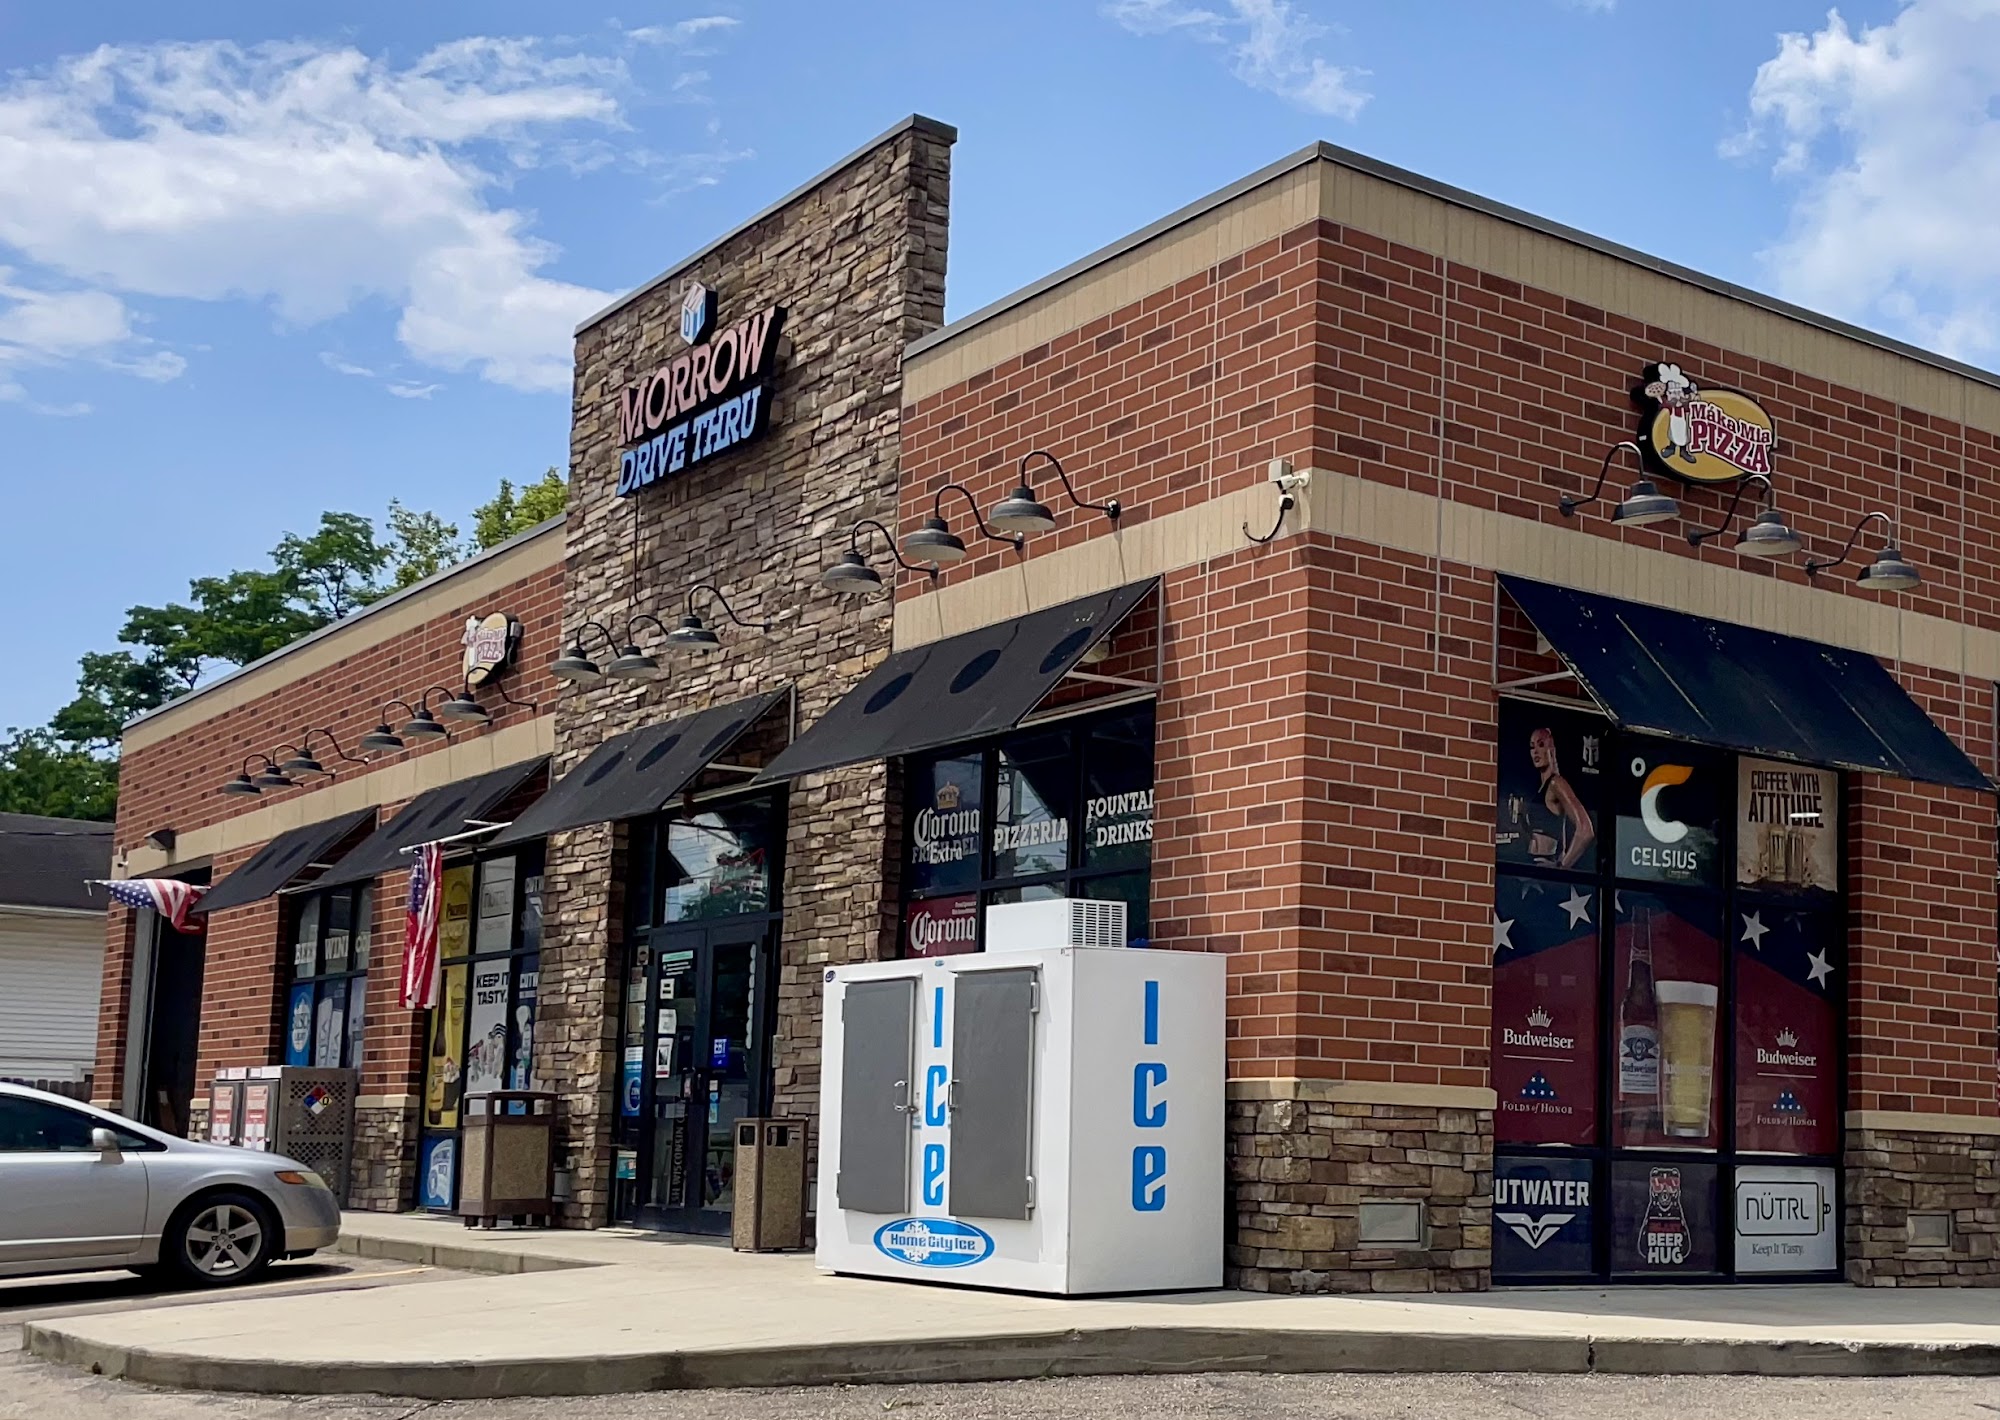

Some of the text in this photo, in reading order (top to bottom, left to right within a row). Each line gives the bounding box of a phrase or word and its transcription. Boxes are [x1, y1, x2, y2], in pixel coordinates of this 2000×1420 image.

[621, 305, 776, 446] MORROW
[616, 384, 762, 497] DRIVE THRU
[1690, 420, 1770, 474] PIZZA
[1751, 771, 1820, 793] COFFEE WITH
[1087, 789, 1154, 818] FOUNTAI
[1748, 792, 1824, 828] ATTITUDE
[913, 807, 980, 847] Corona
[993, 818, 1068, 851] PIZZERIA
[1096, 819, 1154, 847] DRINKS
[926, 841, 963, 865] Extra
[1632, 847, 1697, 870] CELSIUS
[910, 910, 976, 955] Corona
[476, 973, 500, 988] KEEP
[502, 972, 510, 986] IT
[477, 990, 508, 1005] TASTY.
[1503, 1028, 1574, 1049] Budweiser
[1757, 1048, 1816, 1066] Budweiser
[1492, 1179, 1589, 1206] UTWATER
[890, 1233, 976, 1251] Home City Ice
[1648, 1232, 1683, 1247] BEER
[1752, 1244, 1773, 1256] Keep
[1647, 1246, 1684, 1264] HUG
